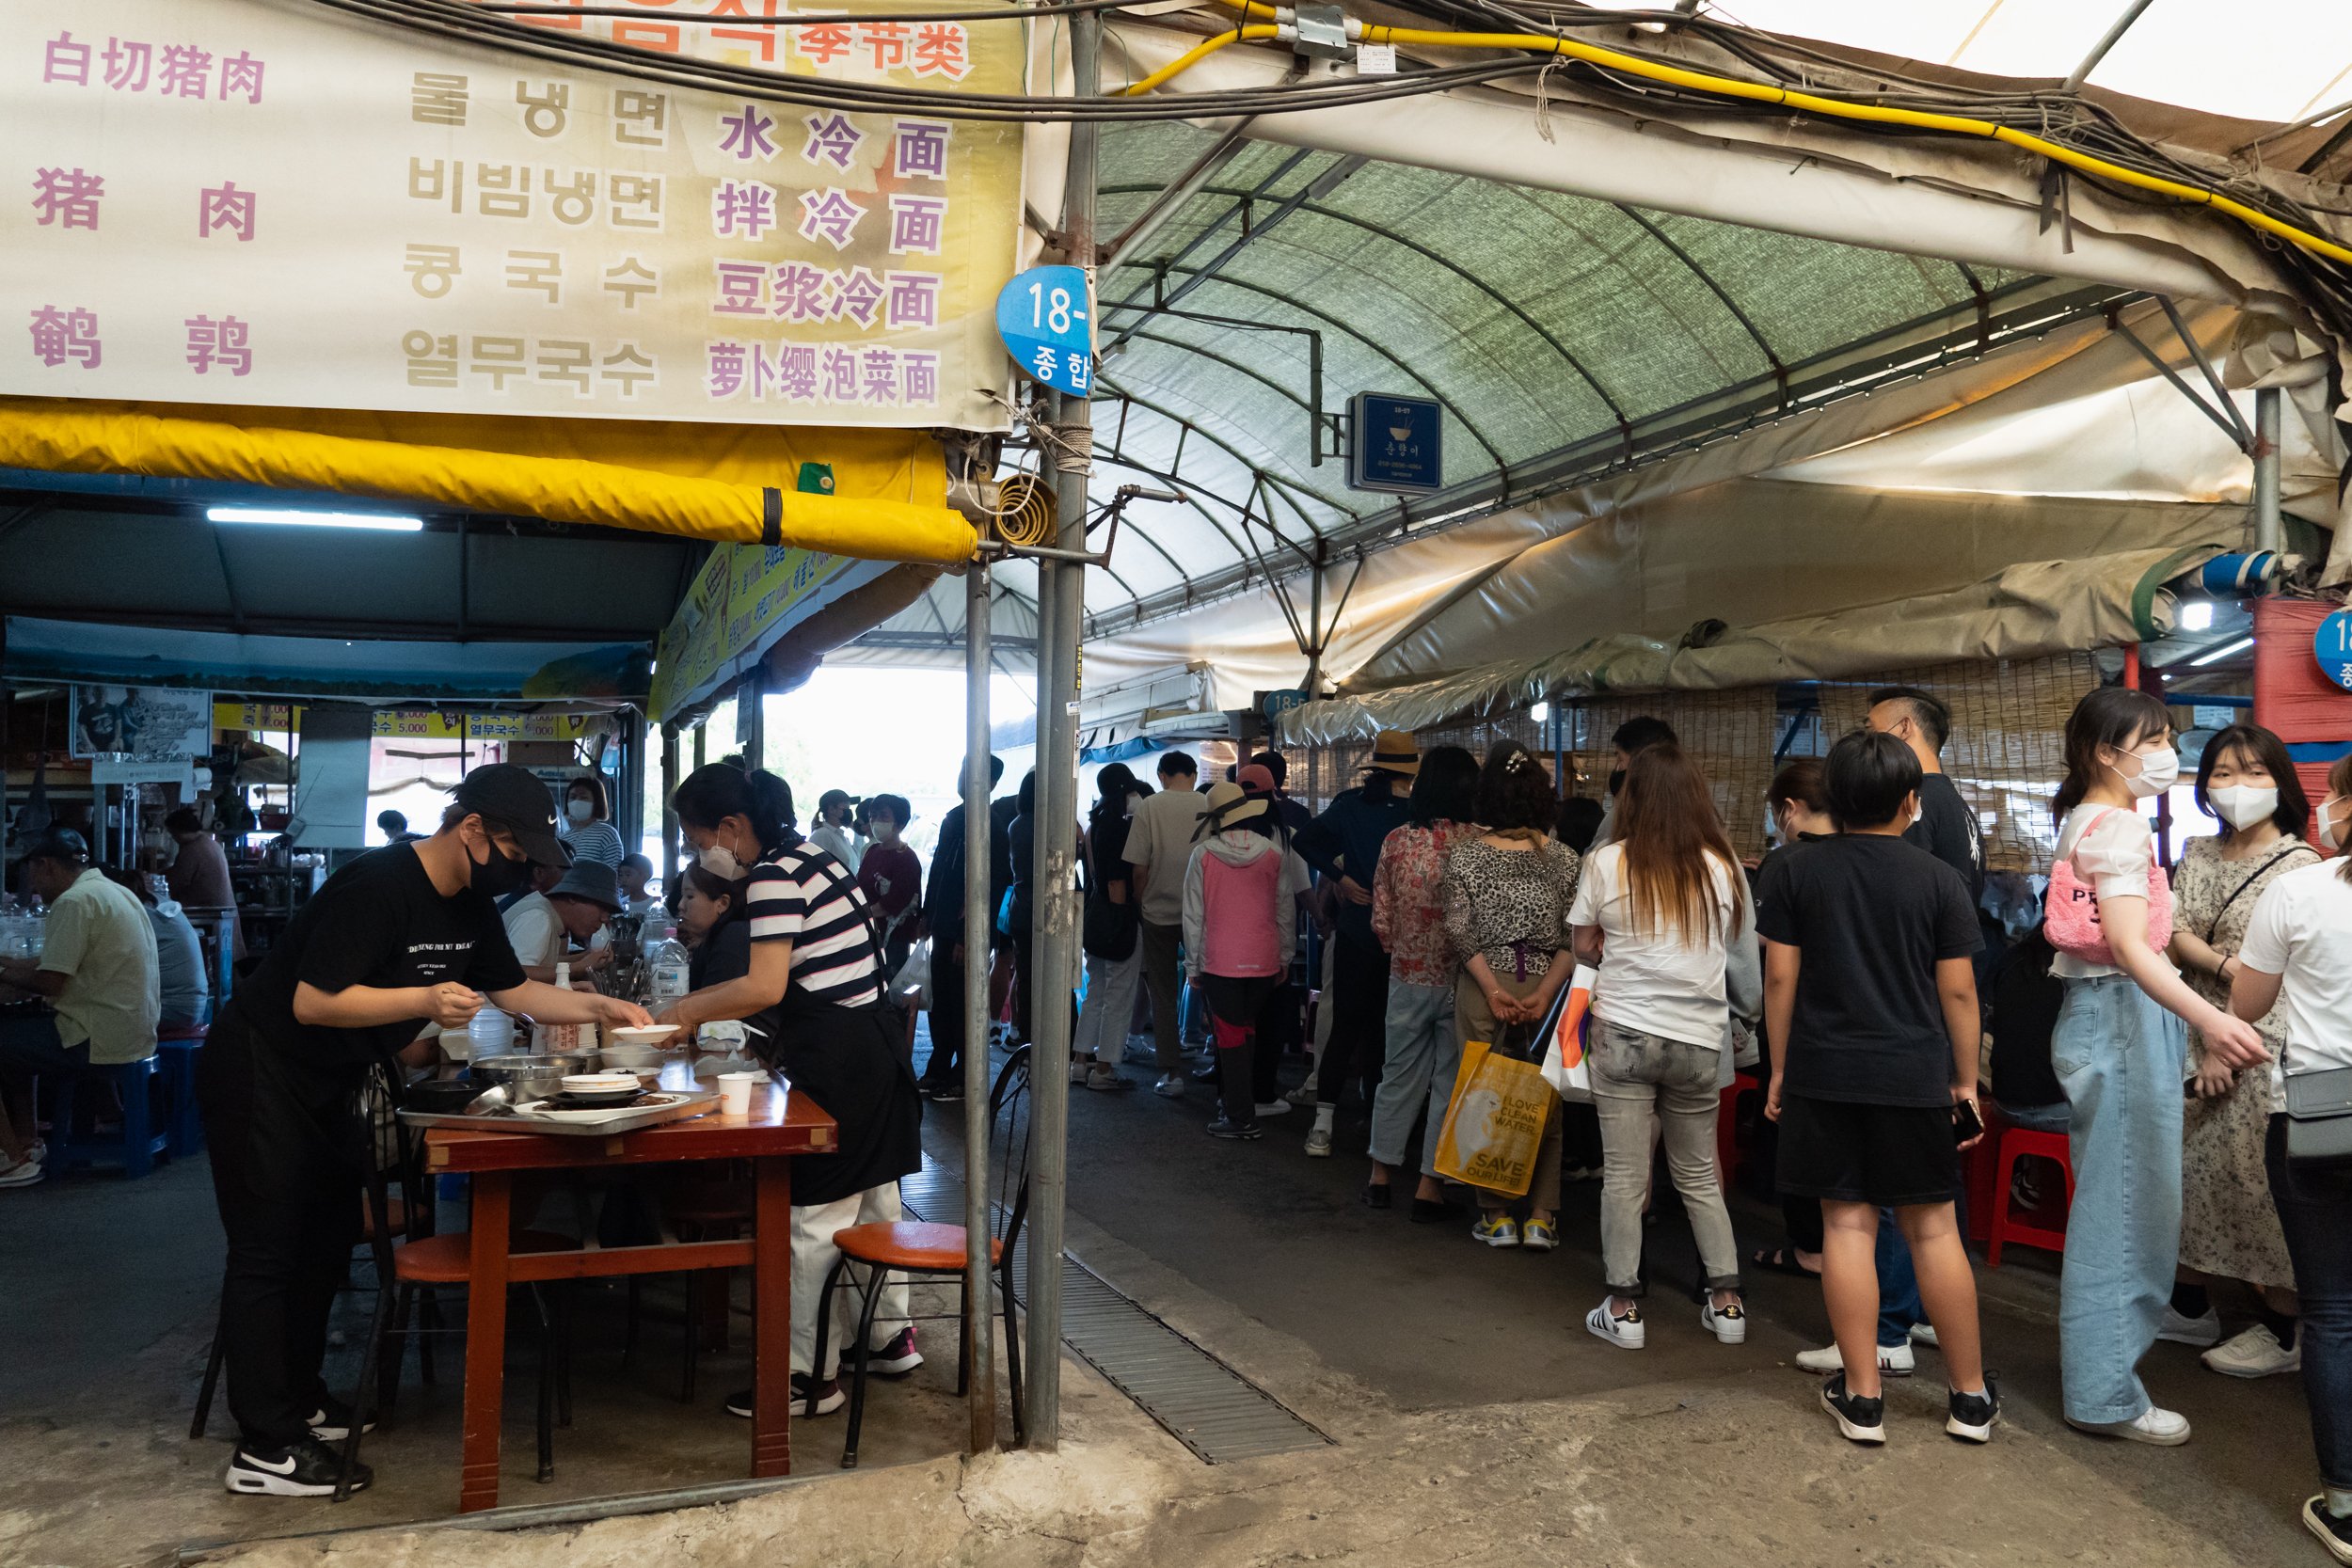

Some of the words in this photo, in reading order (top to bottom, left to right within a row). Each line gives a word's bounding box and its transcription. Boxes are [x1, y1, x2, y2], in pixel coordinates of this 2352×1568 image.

[43, 31, 265, 104] 白切猪肉
[721, 105, 947, 177] 水冷面
[408, 156, 660, 229] 비빔냉면
[717, 182, 943, 252] 拌冷面
[714, 262, 939, 326] 豆浆冷面
[402, 330, 656, 396] 열무국수
[708, 342, 936, 404] 萝卜缨泡菜面
[1033, 345, 1090, 389] 종합
[2336, 618, 2352, 651] 1
[399, 722, 427, 733] 5,000
[470, 724, 519, 736] 열무국수
[1501, 1106, 1537, 1124] CLEAN
[1508, 1097, 1540, 1114] LOVE
[1467, 1166, 1492, 1180] OUR
[1475, 1153, 1524, 1177] SAVE
